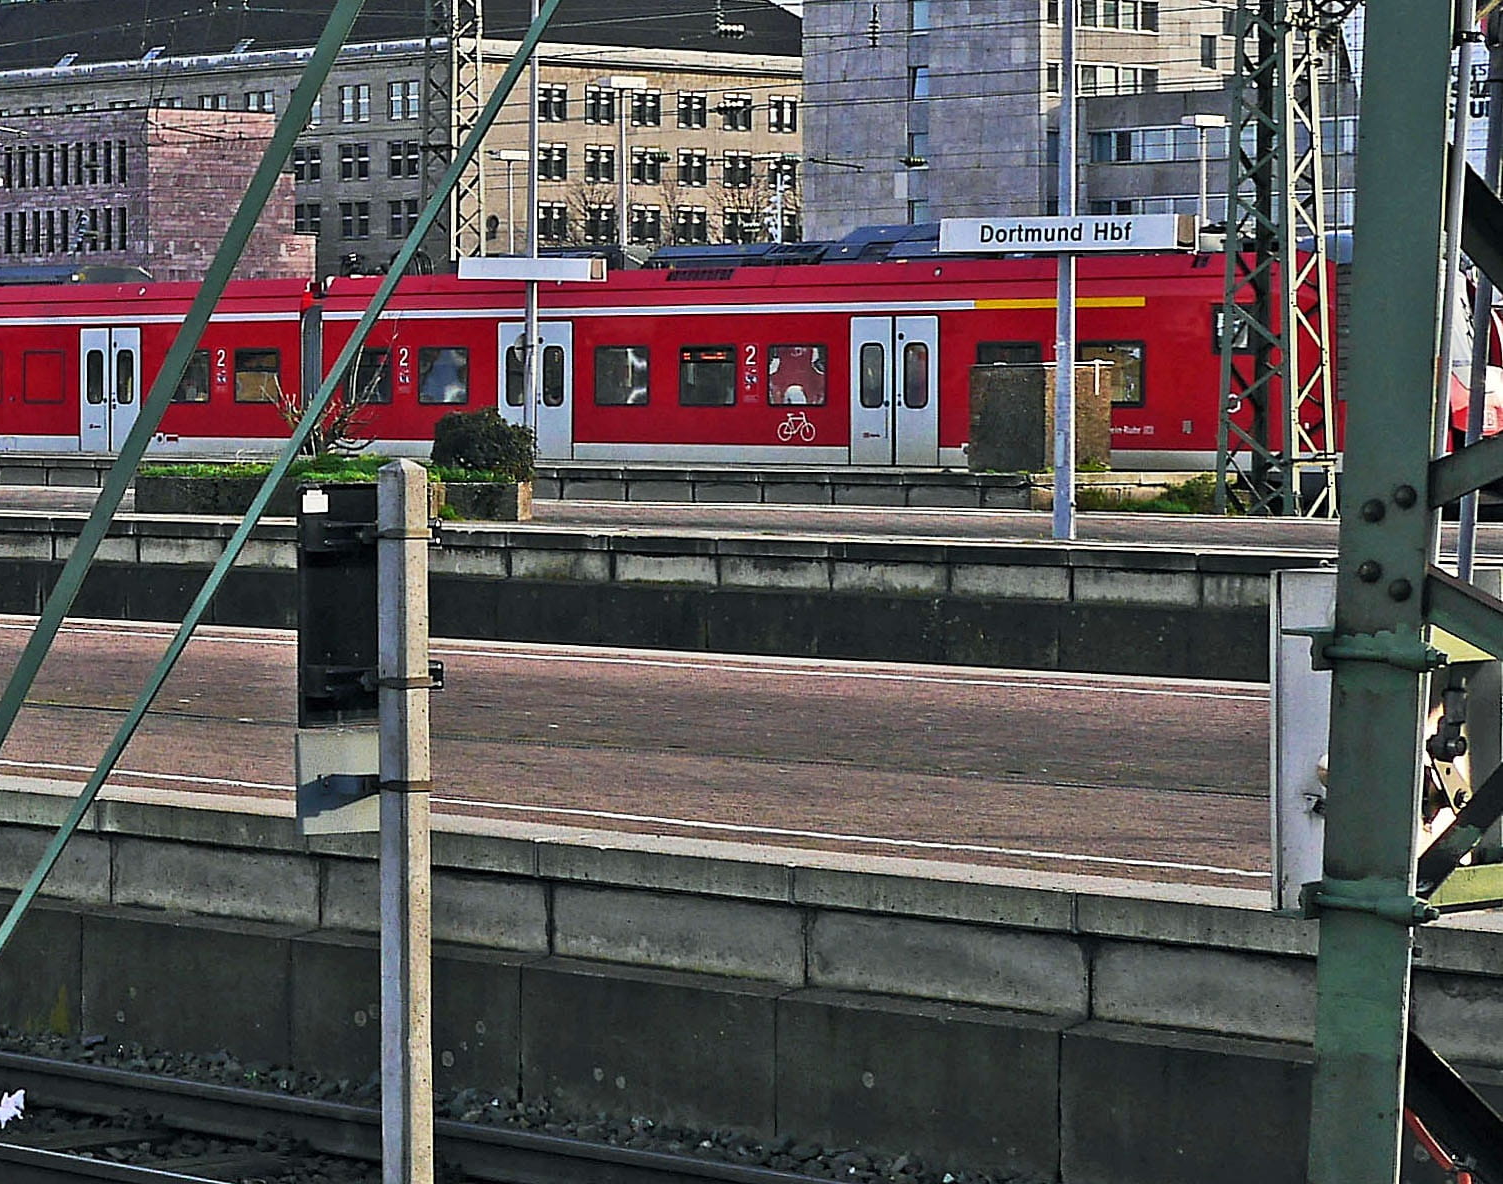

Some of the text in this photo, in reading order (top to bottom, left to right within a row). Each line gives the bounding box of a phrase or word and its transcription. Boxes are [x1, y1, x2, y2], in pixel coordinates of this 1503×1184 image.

[980, 221, 1133, 244] Dortmund Hbf
[217, 349, 225, 366] 2
[399, 347, 408, 366] 2
[745, 345, 756, 365] 2
